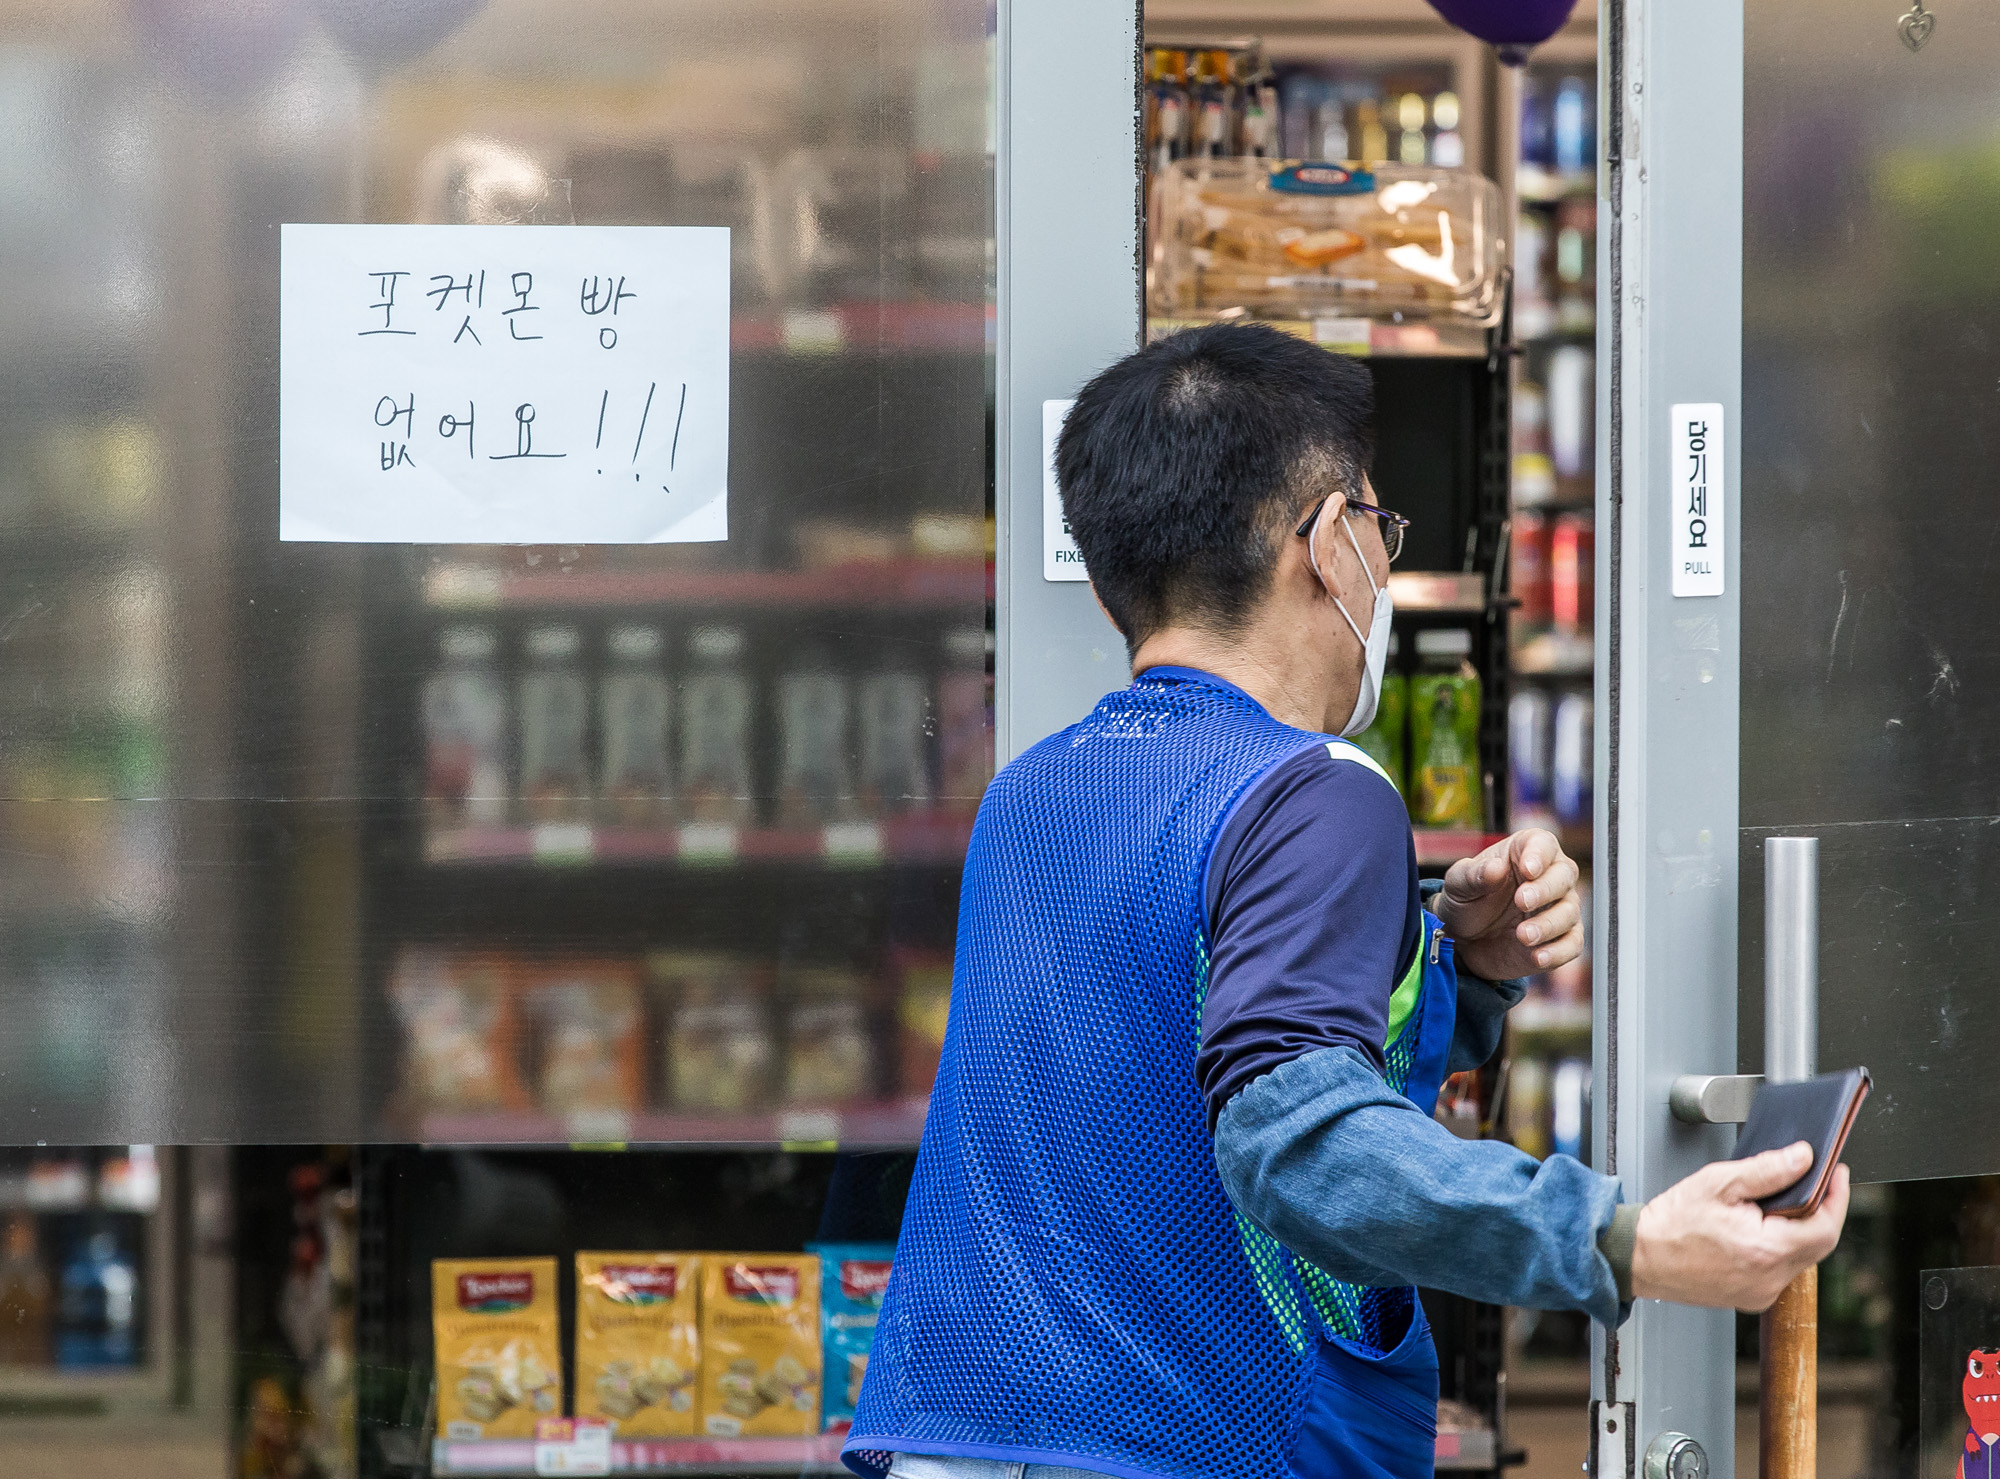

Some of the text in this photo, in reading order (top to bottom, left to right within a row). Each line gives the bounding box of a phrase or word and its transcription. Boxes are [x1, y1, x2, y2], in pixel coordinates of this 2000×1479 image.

[580, 275, 638, 350] 빵
[1688, 420, 1708, 548] 당기세요
[1055, 550, 1086, 563] FIXE
[1684, 562, 1712, 575] PULL
